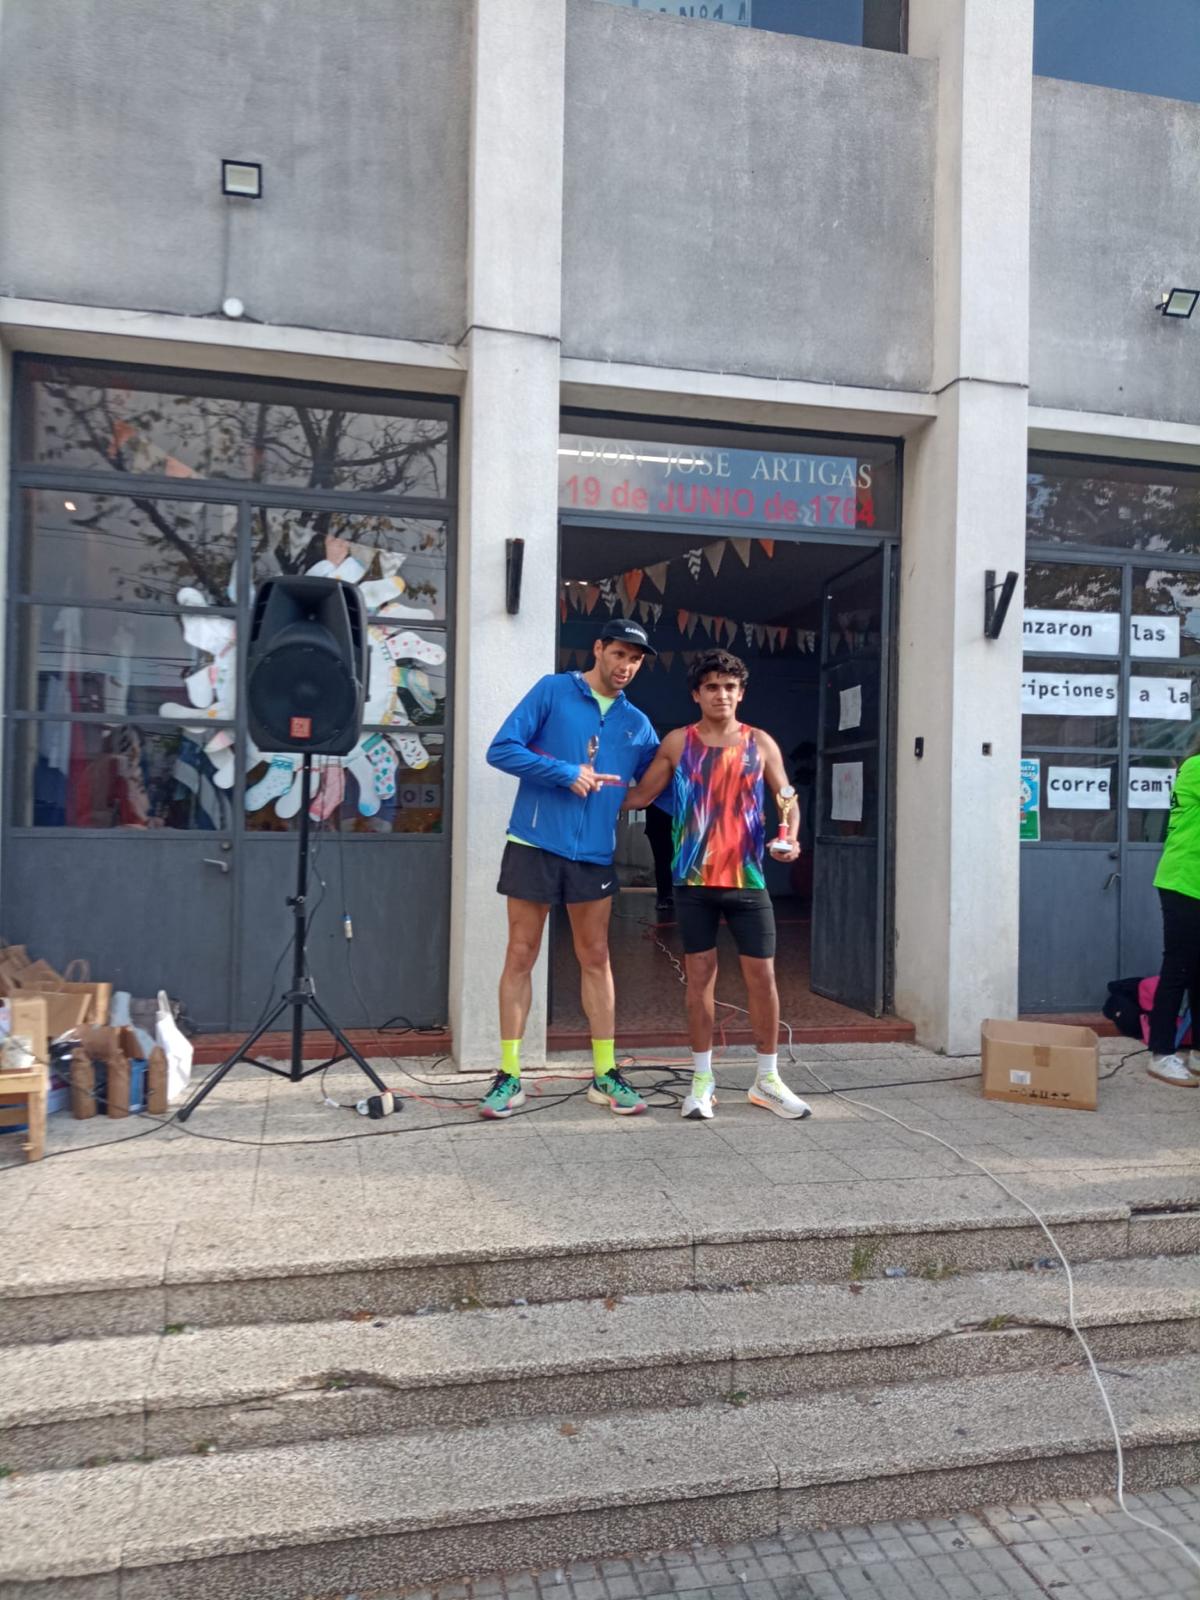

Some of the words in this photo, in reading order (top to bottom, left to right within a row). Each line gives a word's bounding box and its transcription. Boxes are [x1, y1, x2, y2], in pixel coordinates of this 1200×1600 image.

[577, 440, 643, 468] DON
[751, 455, 872, 489] ARTIGAS
[566, 476, 601, 507] 19
[611, 479, 648, 511] de
[657, 480, 754, 518] JUNIO
[764, 490, 798, 523] de
[1131, 624, 1165, 641] las
[1139, 690, 1150, 702] a
[1167, 688, 1189, 704] la
[1050, 778, 1108, 792] corre
